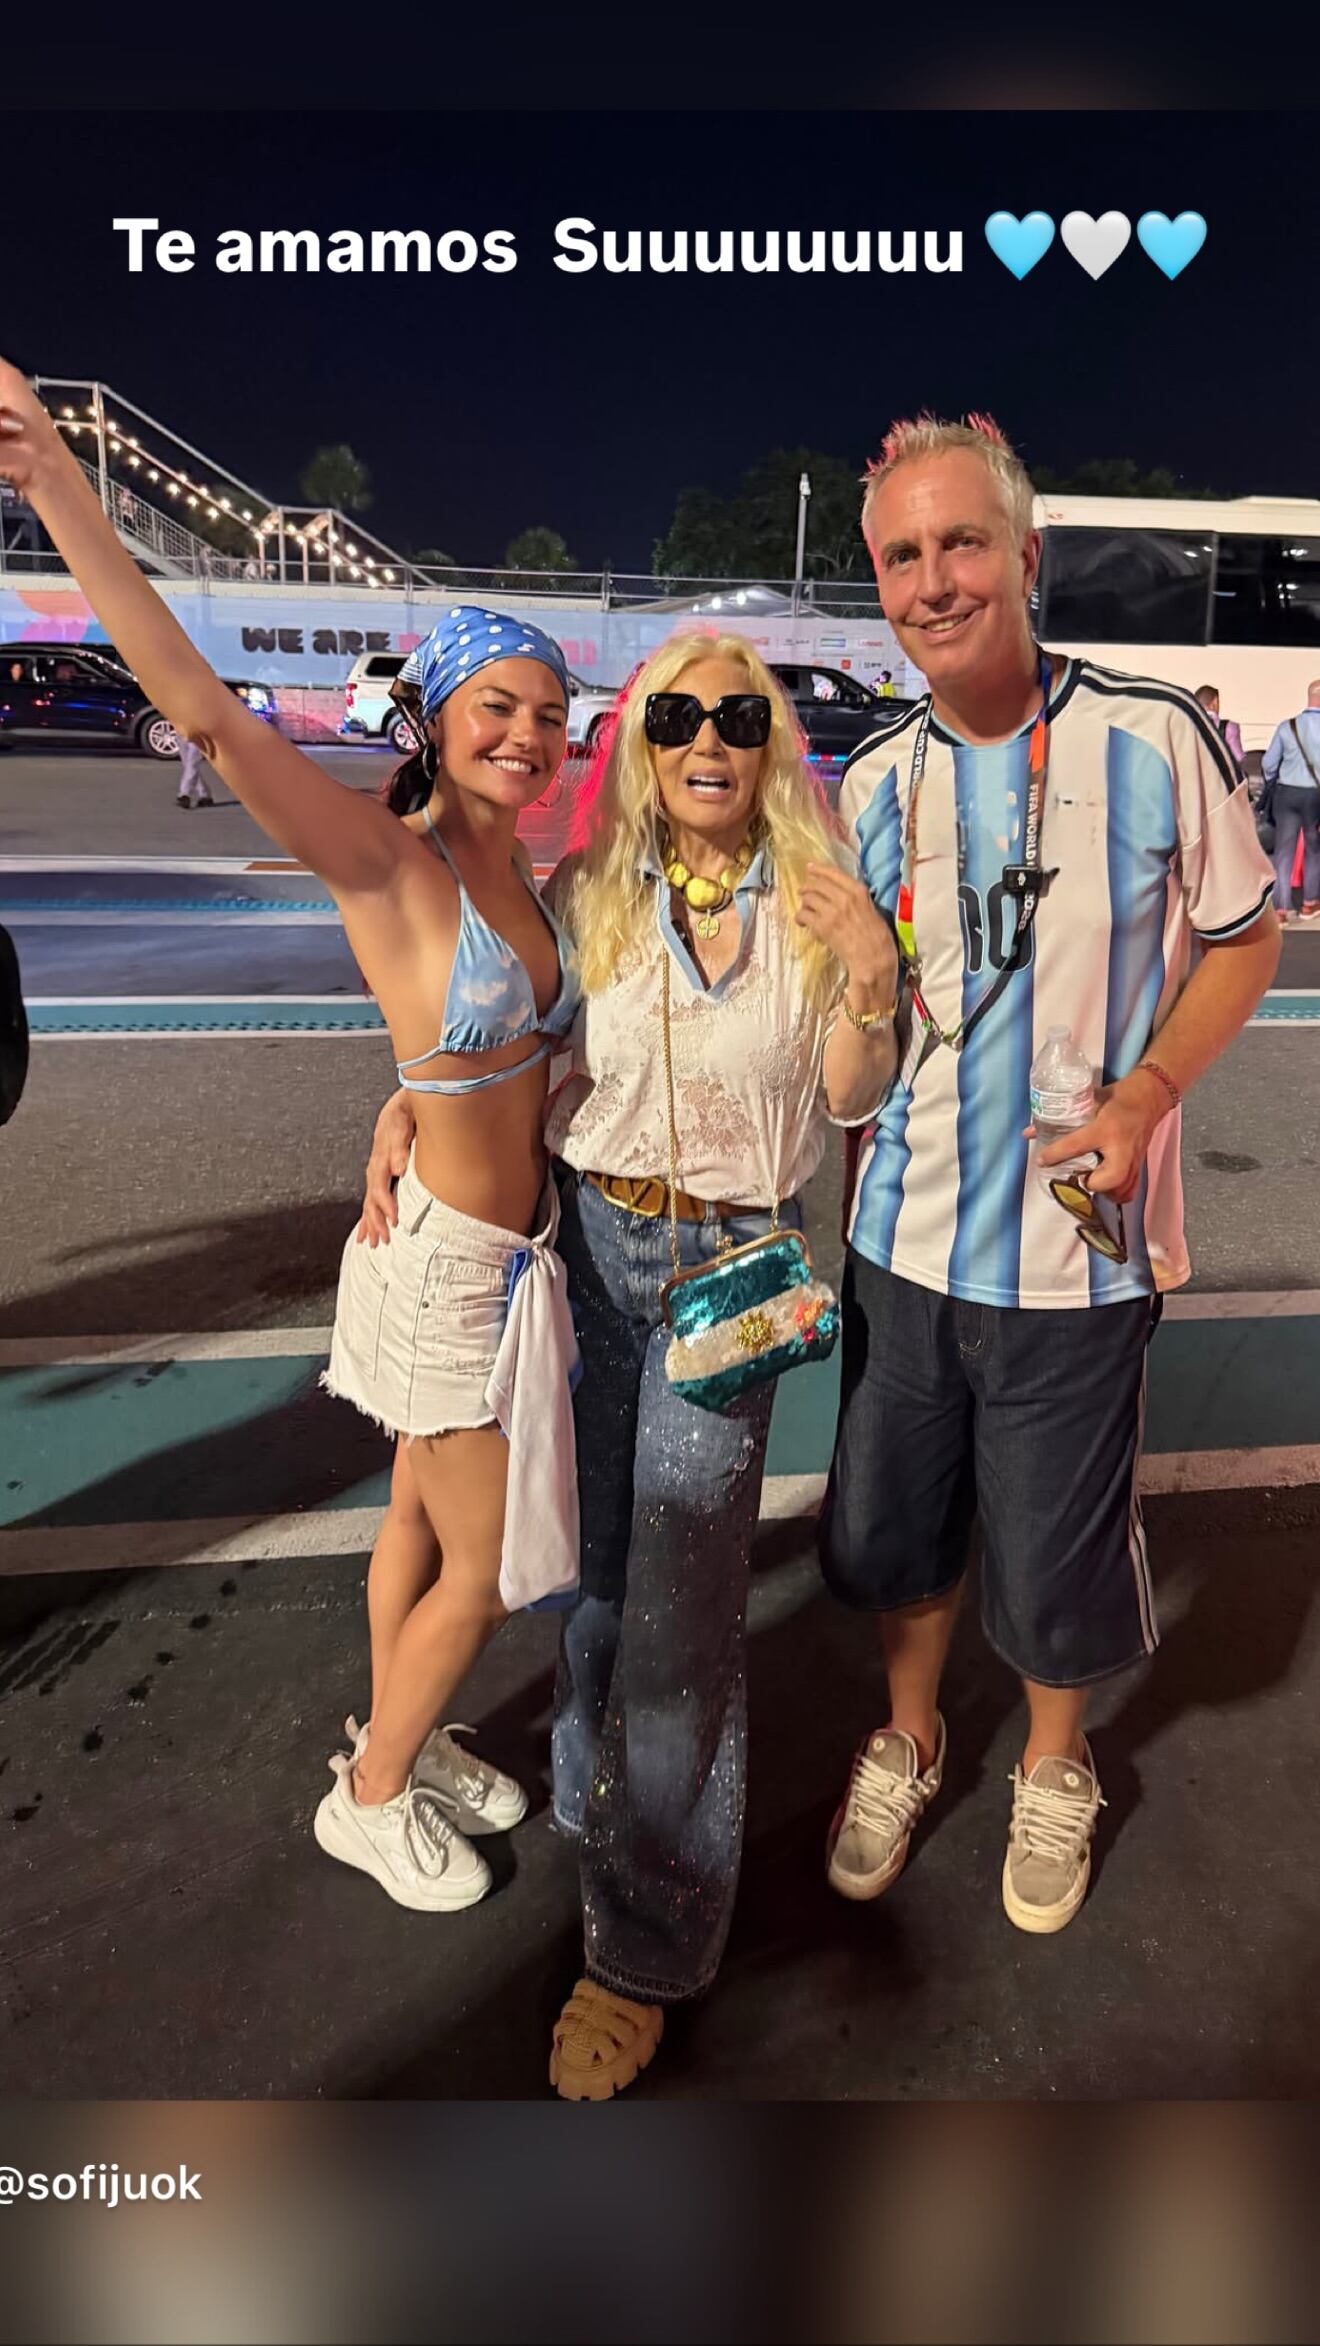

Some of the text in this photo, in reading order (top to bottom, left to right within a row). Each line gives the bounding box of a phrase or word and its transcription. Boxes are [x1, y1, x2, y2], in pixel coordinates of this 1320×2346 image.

[241, 627, 304, 654] WE
[1029, 783, 1040, 812] FIFA
[1025, 813, 1038, 861] WORLD
